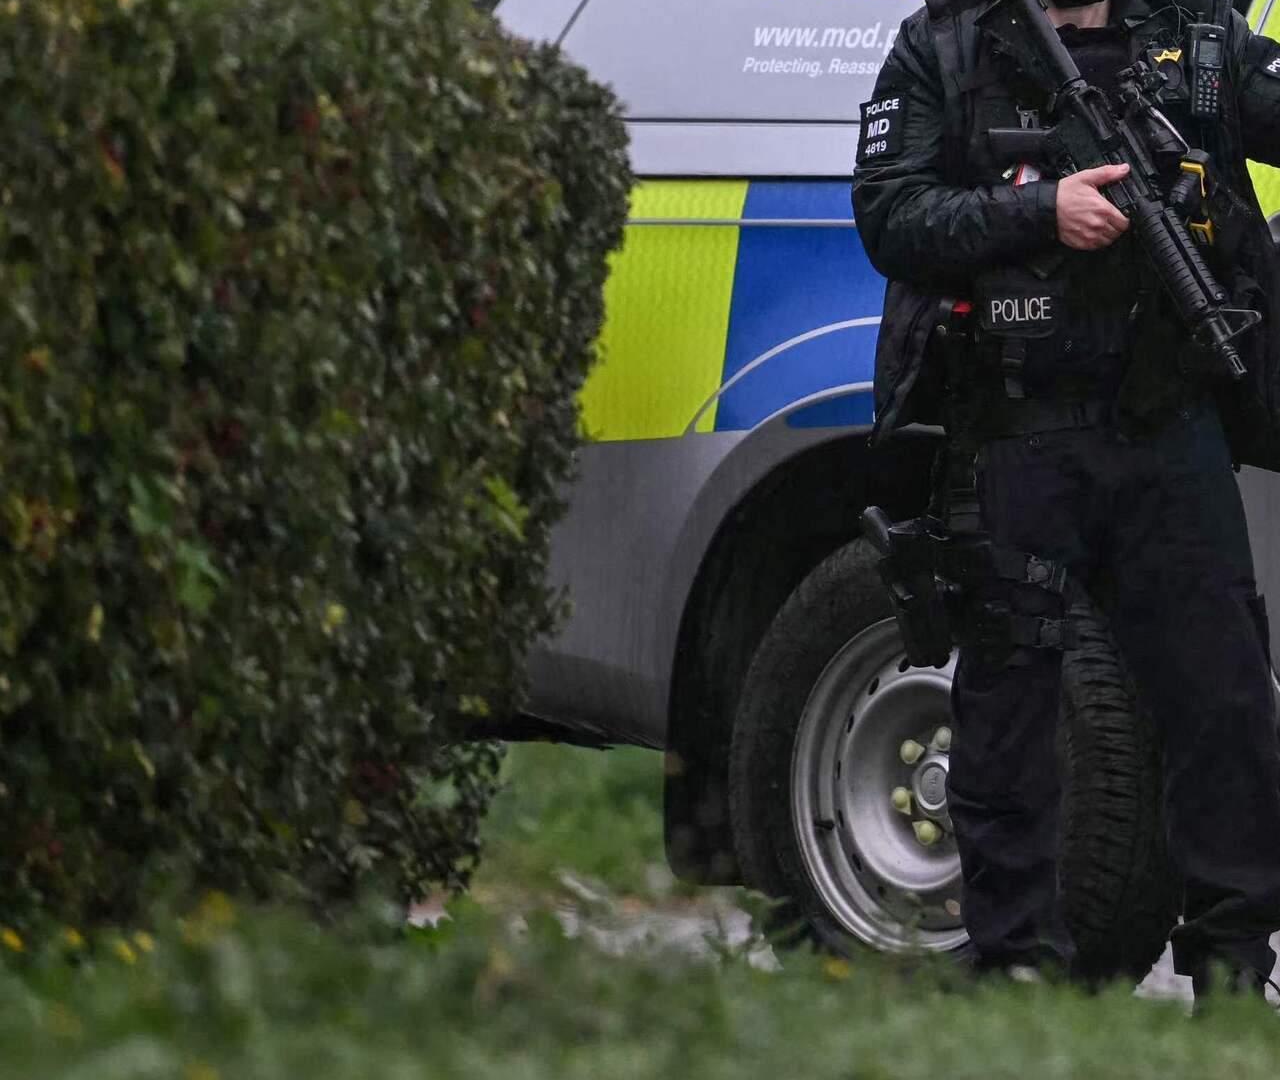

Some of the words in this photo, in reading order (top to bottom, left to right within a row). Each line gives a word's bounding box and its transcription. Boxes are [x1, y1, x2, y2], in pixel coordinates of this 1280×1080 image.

[754, 22, 899, 55] www.mod.p
[743, 57, 823, 77] Protecting,
[866, 99, 899, 117] POLICE
[866, 118, 890, 138] MD
[865, 140, 887, 158] 4819
[991, 296, 1052, 323] POLICE
